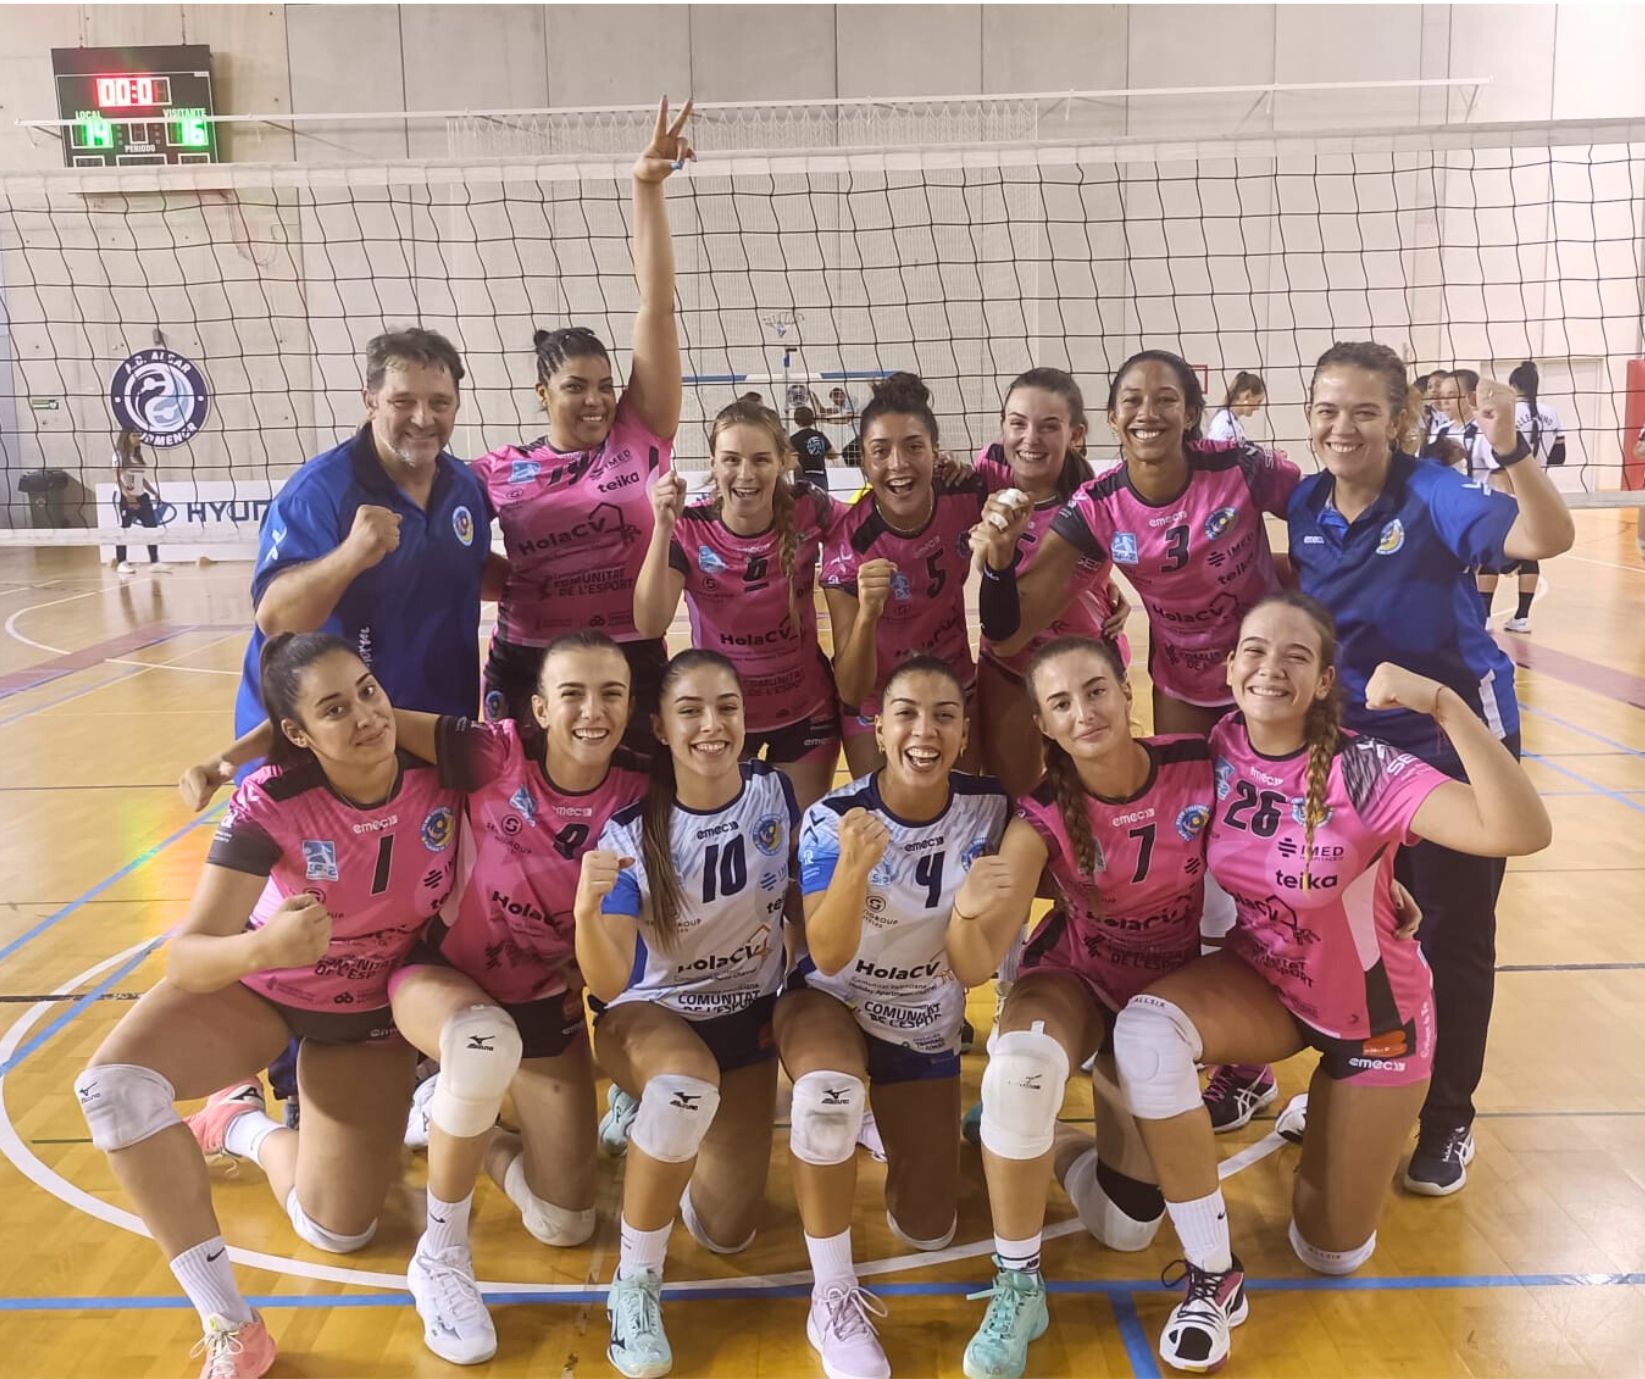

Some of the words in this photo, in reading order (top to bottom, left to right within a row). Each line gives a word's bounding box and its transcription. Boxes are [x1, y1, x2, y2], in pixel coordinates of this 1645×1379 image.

[75, 111, 102, 120] LOCAL
[163, 108, 206, 119] VISITANTE
[597, 471, 640, 493] teika
[518, 517, 608, 556] HolaCV
[1161, 524, 1190, 573] 3
[926, 547, 947, 599] 5
[720, 625, 792, 646] HolaCV
[1223, 778, 1288, 838] 26
[370, 832, 395, 895] 1
[702, 833, 748, 905] 10
[1128, 822, 1156, 885] 7
[915, 850, 946, 909] 4
[1275, 869, 1339, 890] teika
[854, 959, 941, 980] HolaCV
[678, 990, 761, 1006] COMUNITAT
